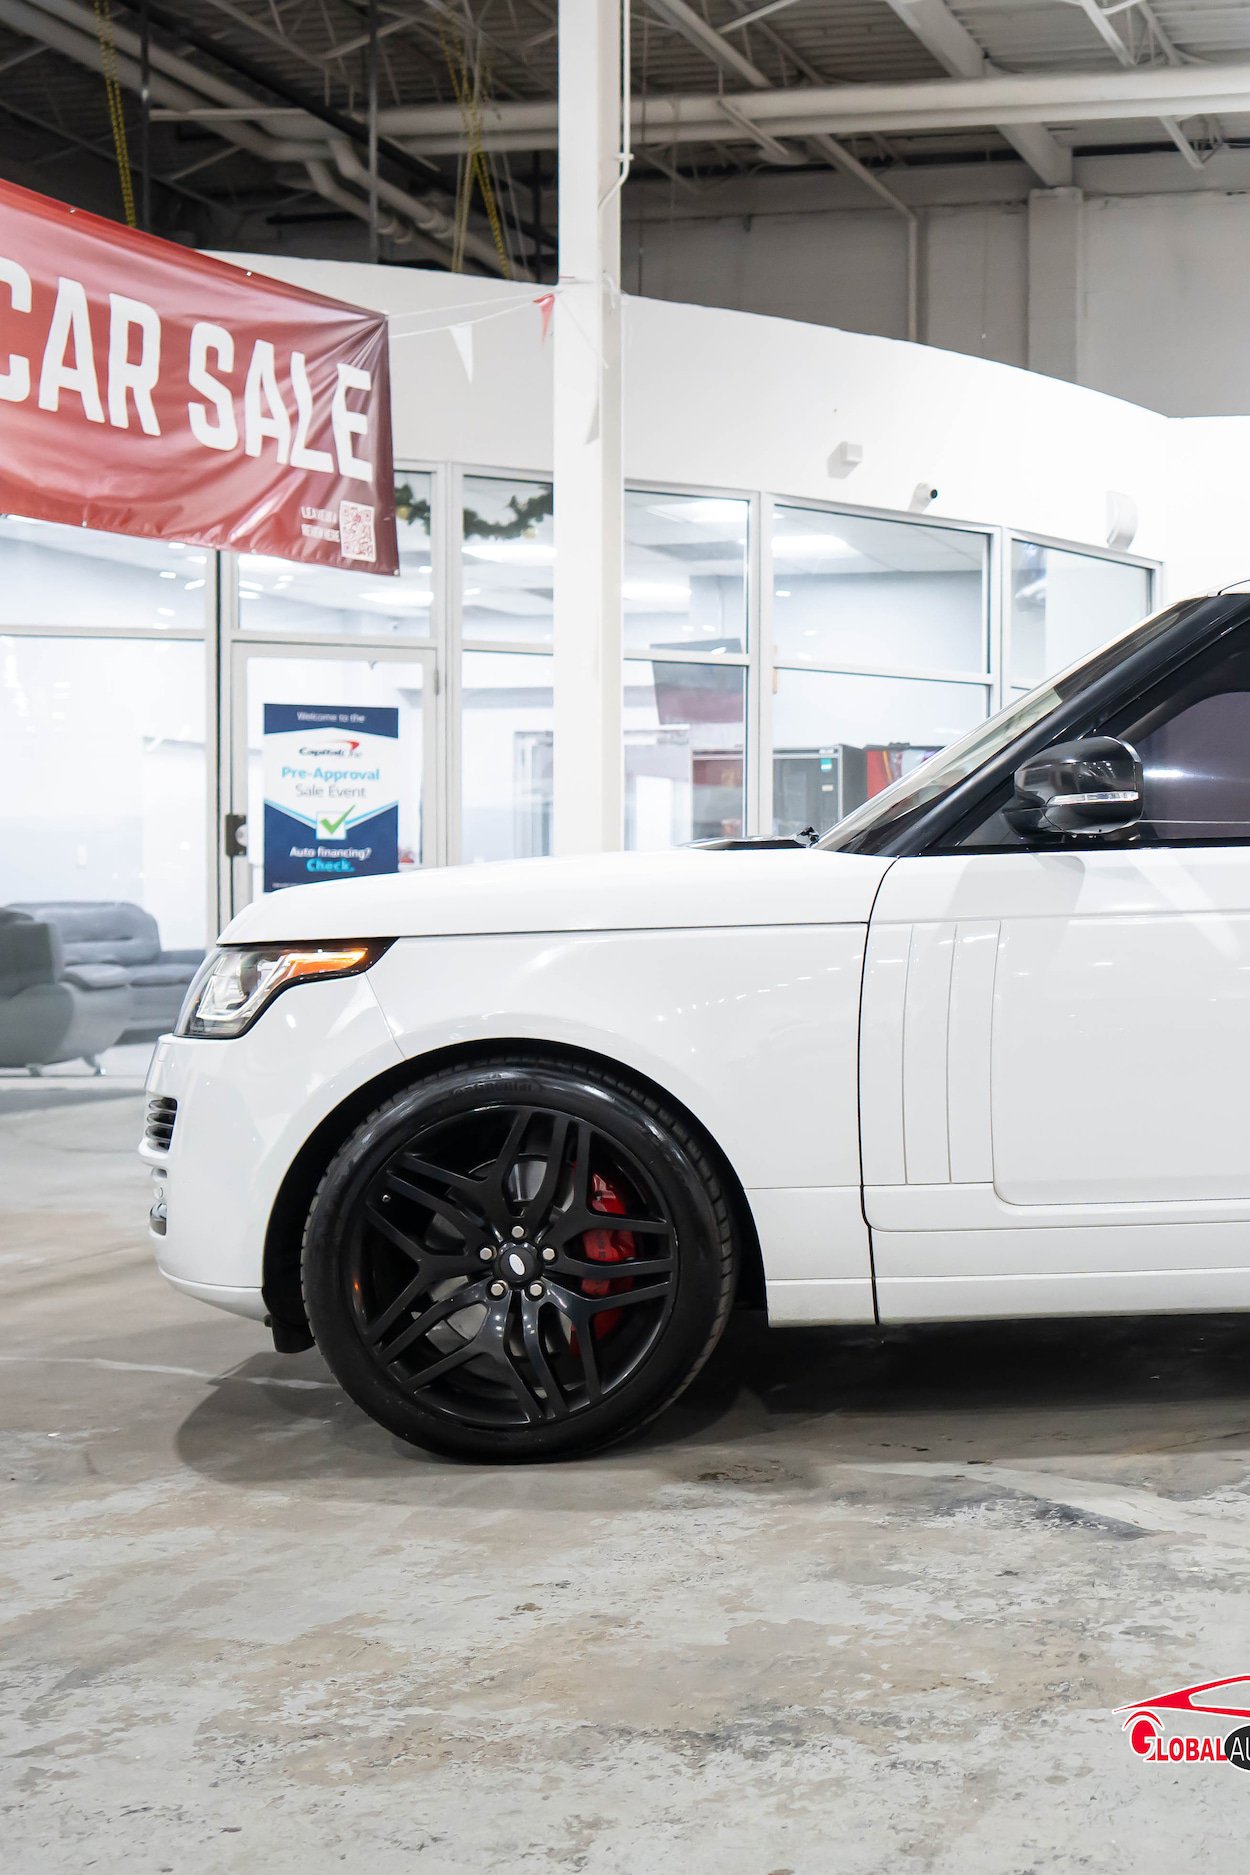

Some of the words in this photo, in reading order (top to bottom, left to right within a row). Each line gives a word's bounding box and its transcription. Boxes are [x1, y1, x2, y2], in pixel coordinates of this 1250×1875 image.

[0, 256, 161, 436] CAR
[188, 322, 373, 482] SALE
[297, 711, 337, 721] Welcome
[338, 713, 349, 723] to
[350, 713, 366, 723] the
[281, 767, 380, 783] Pre-Approval
[295, 784, 324, 798] Sale
[328, 785, 366, 798] Event
[289, 846, 315, 857] Auto
[317, 846, 372, 861] financing?
[306, 858, 355, 873] Check.
